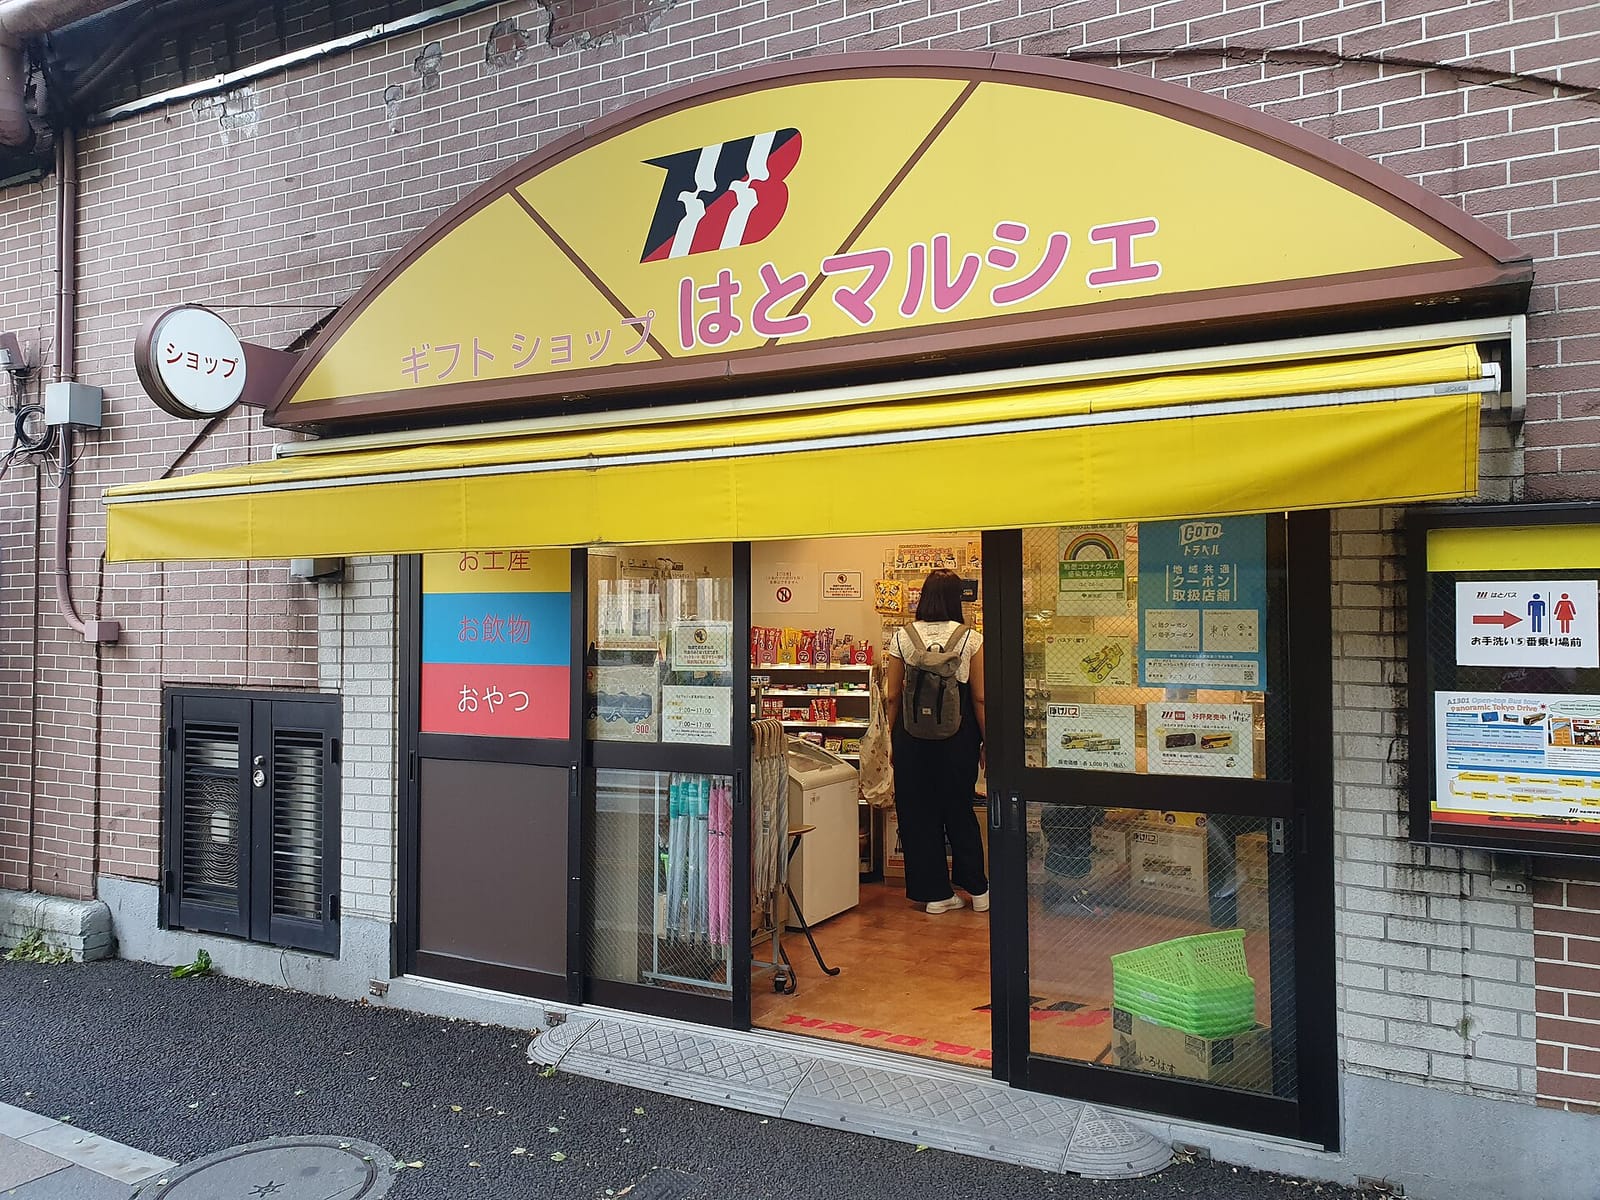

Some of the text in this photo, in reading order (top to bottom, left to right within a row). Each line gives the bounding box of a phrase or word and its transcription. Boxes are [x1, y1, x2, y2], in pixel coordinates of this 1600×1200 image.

[511, 309, 656, 369] ショップ
[166, 342, 239, 378] ショップ
[1183, 544, 1220, 556] トラベル
[1172, 575, 1230, 588] クーポン
[1172, 588, 1231, 602] 取扱店舗
[457, 612, 532, 644] お飲物
[457, 684, 529, 713] おやつ
[1492, 704, 1516, 712] Tokyo
[782, 1014, 928, 1047] HATO
[1139, 1051, 1176, 1073] いろはす
